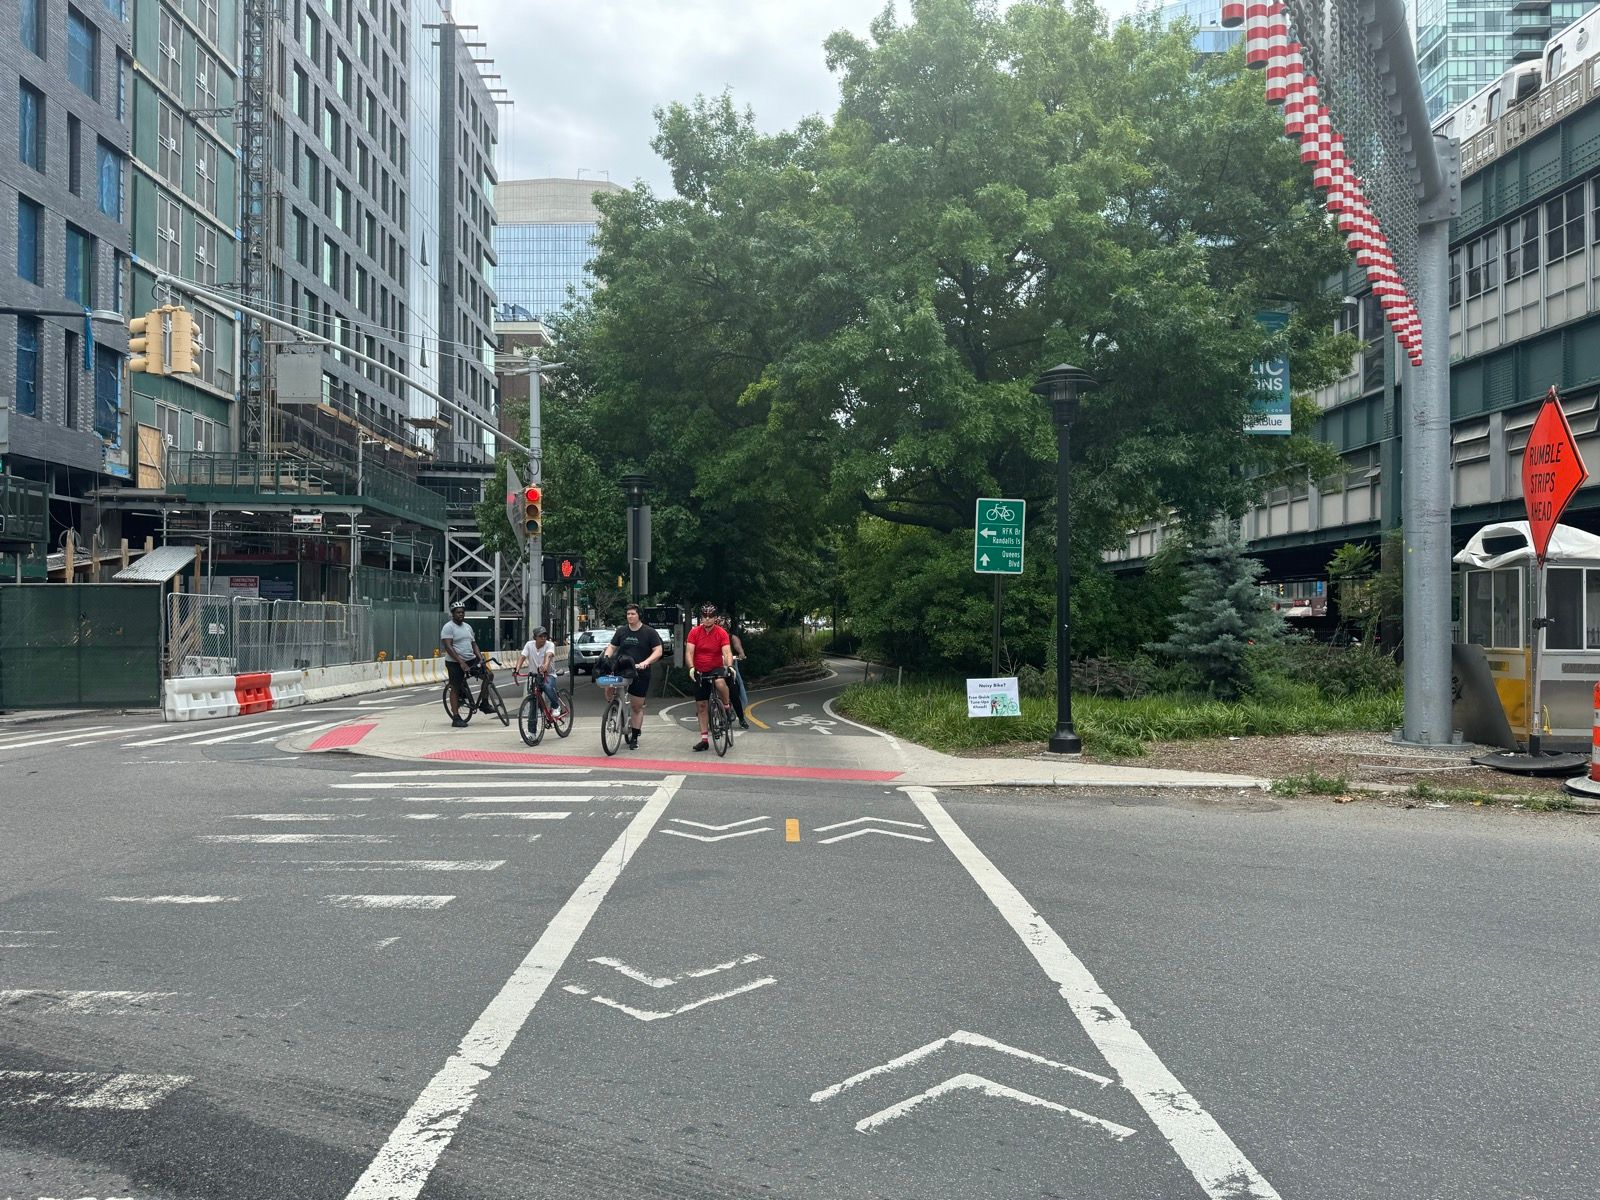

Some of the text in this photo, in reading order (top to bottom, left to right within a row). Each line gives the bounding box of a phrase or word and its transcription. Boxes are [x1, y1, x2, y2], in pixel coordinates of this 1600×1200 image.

[1529, 442, 1564, 466] RUMBLE
[1530, 471, 1556, 494] STRIPS
[1531, 501, 1552, 521] AHEAD
